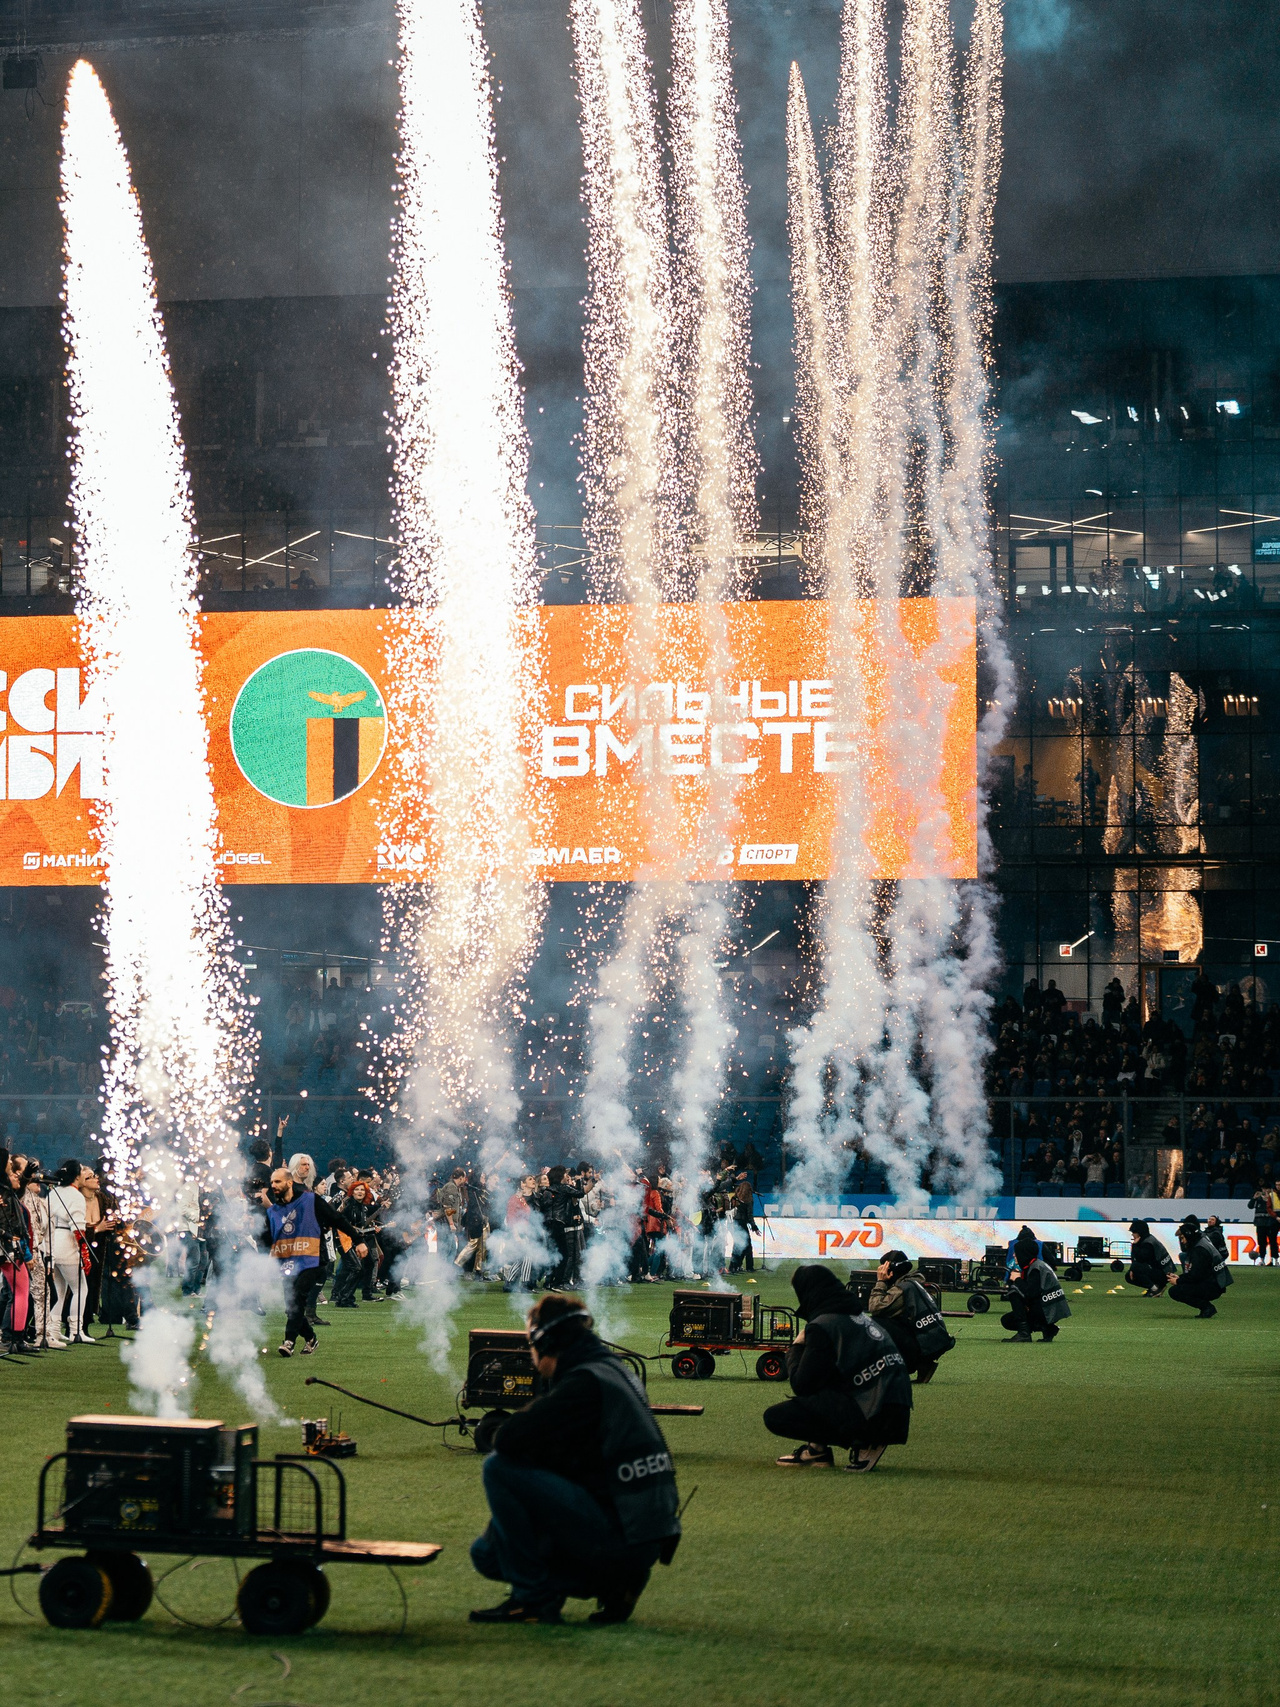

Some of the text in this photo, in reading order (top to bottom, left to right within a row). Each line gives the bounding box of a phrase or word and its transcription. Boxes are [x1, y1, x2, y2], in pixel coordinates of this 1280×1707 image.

[565, 679, 833, 721] СИЛЬНЫЕ
[541, 721, 858, 778] ВМЕСТЕ
[746, 849, 793, 860] СПОРТ
